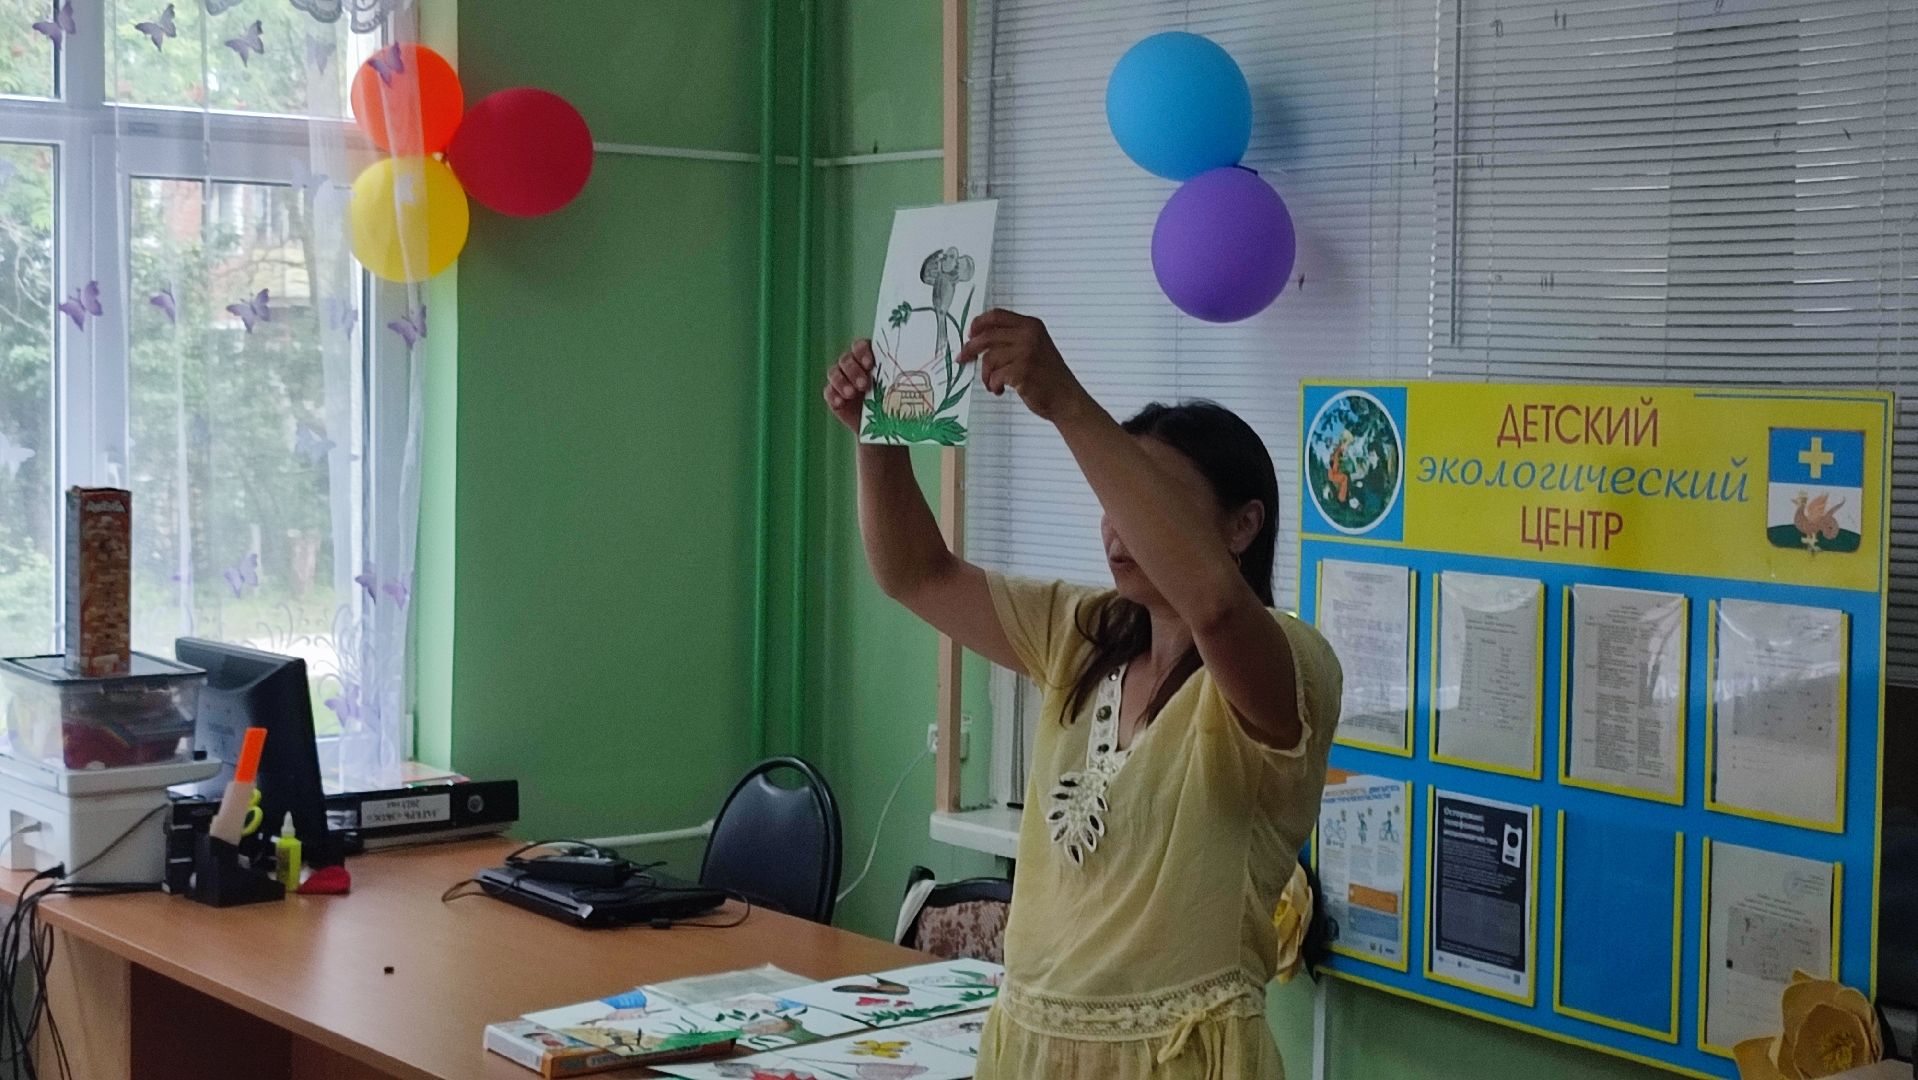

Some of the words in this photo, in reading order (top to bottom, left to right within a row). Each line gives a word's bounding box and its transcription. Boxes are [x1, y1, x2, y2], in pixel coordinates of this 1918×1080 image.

[1496, 396, 1659, 449] ДЕТСКИЙ
[1415, 455, 1750, 503] экологический
[1521, 505, 1624, 552] ЦЕНТР
